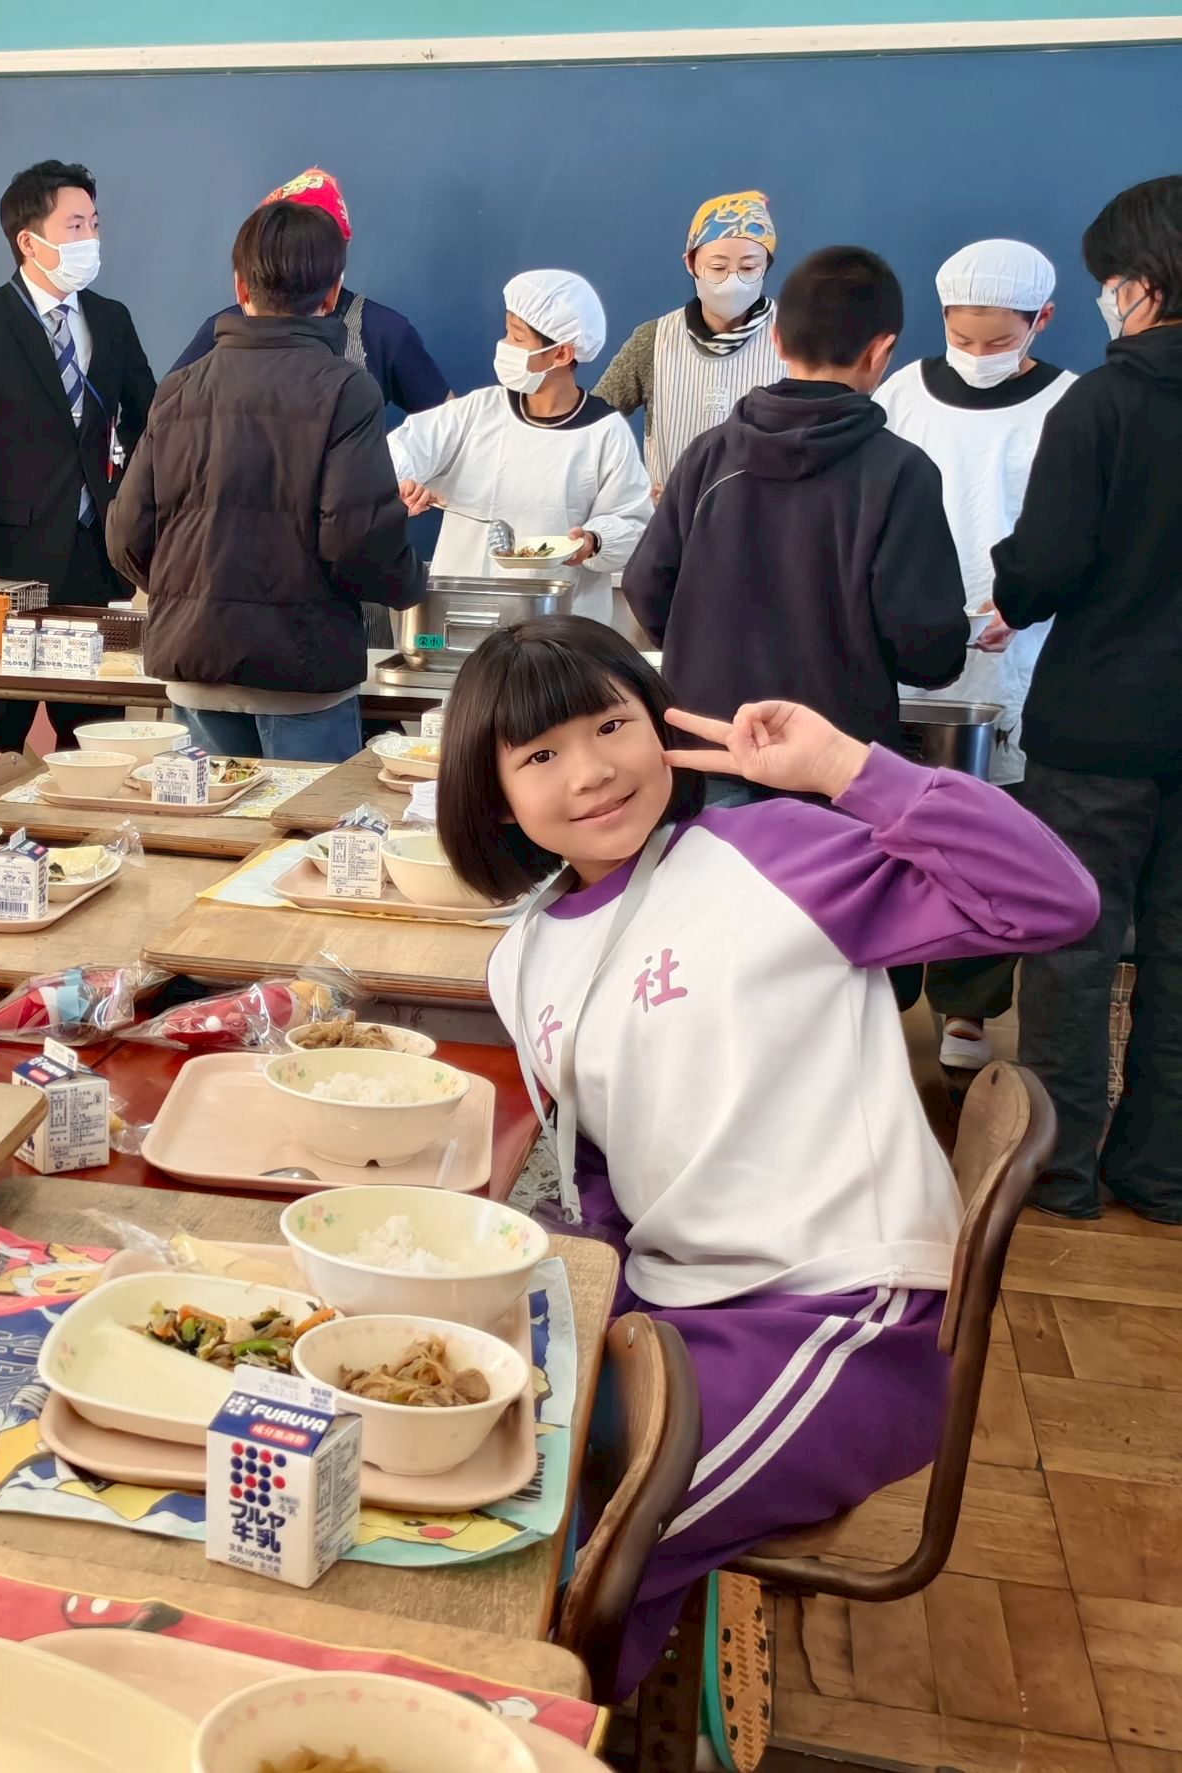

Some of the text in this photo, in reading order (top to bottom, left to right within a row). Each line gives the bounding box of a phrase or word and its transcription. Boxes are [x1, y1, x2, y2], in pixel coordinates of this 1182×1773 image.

[250, 1403, 328, 1433] FURUYA
[229, 1499, 287, 1530] フルヤ
[232, 1518, 282, 1553] 牛乳
